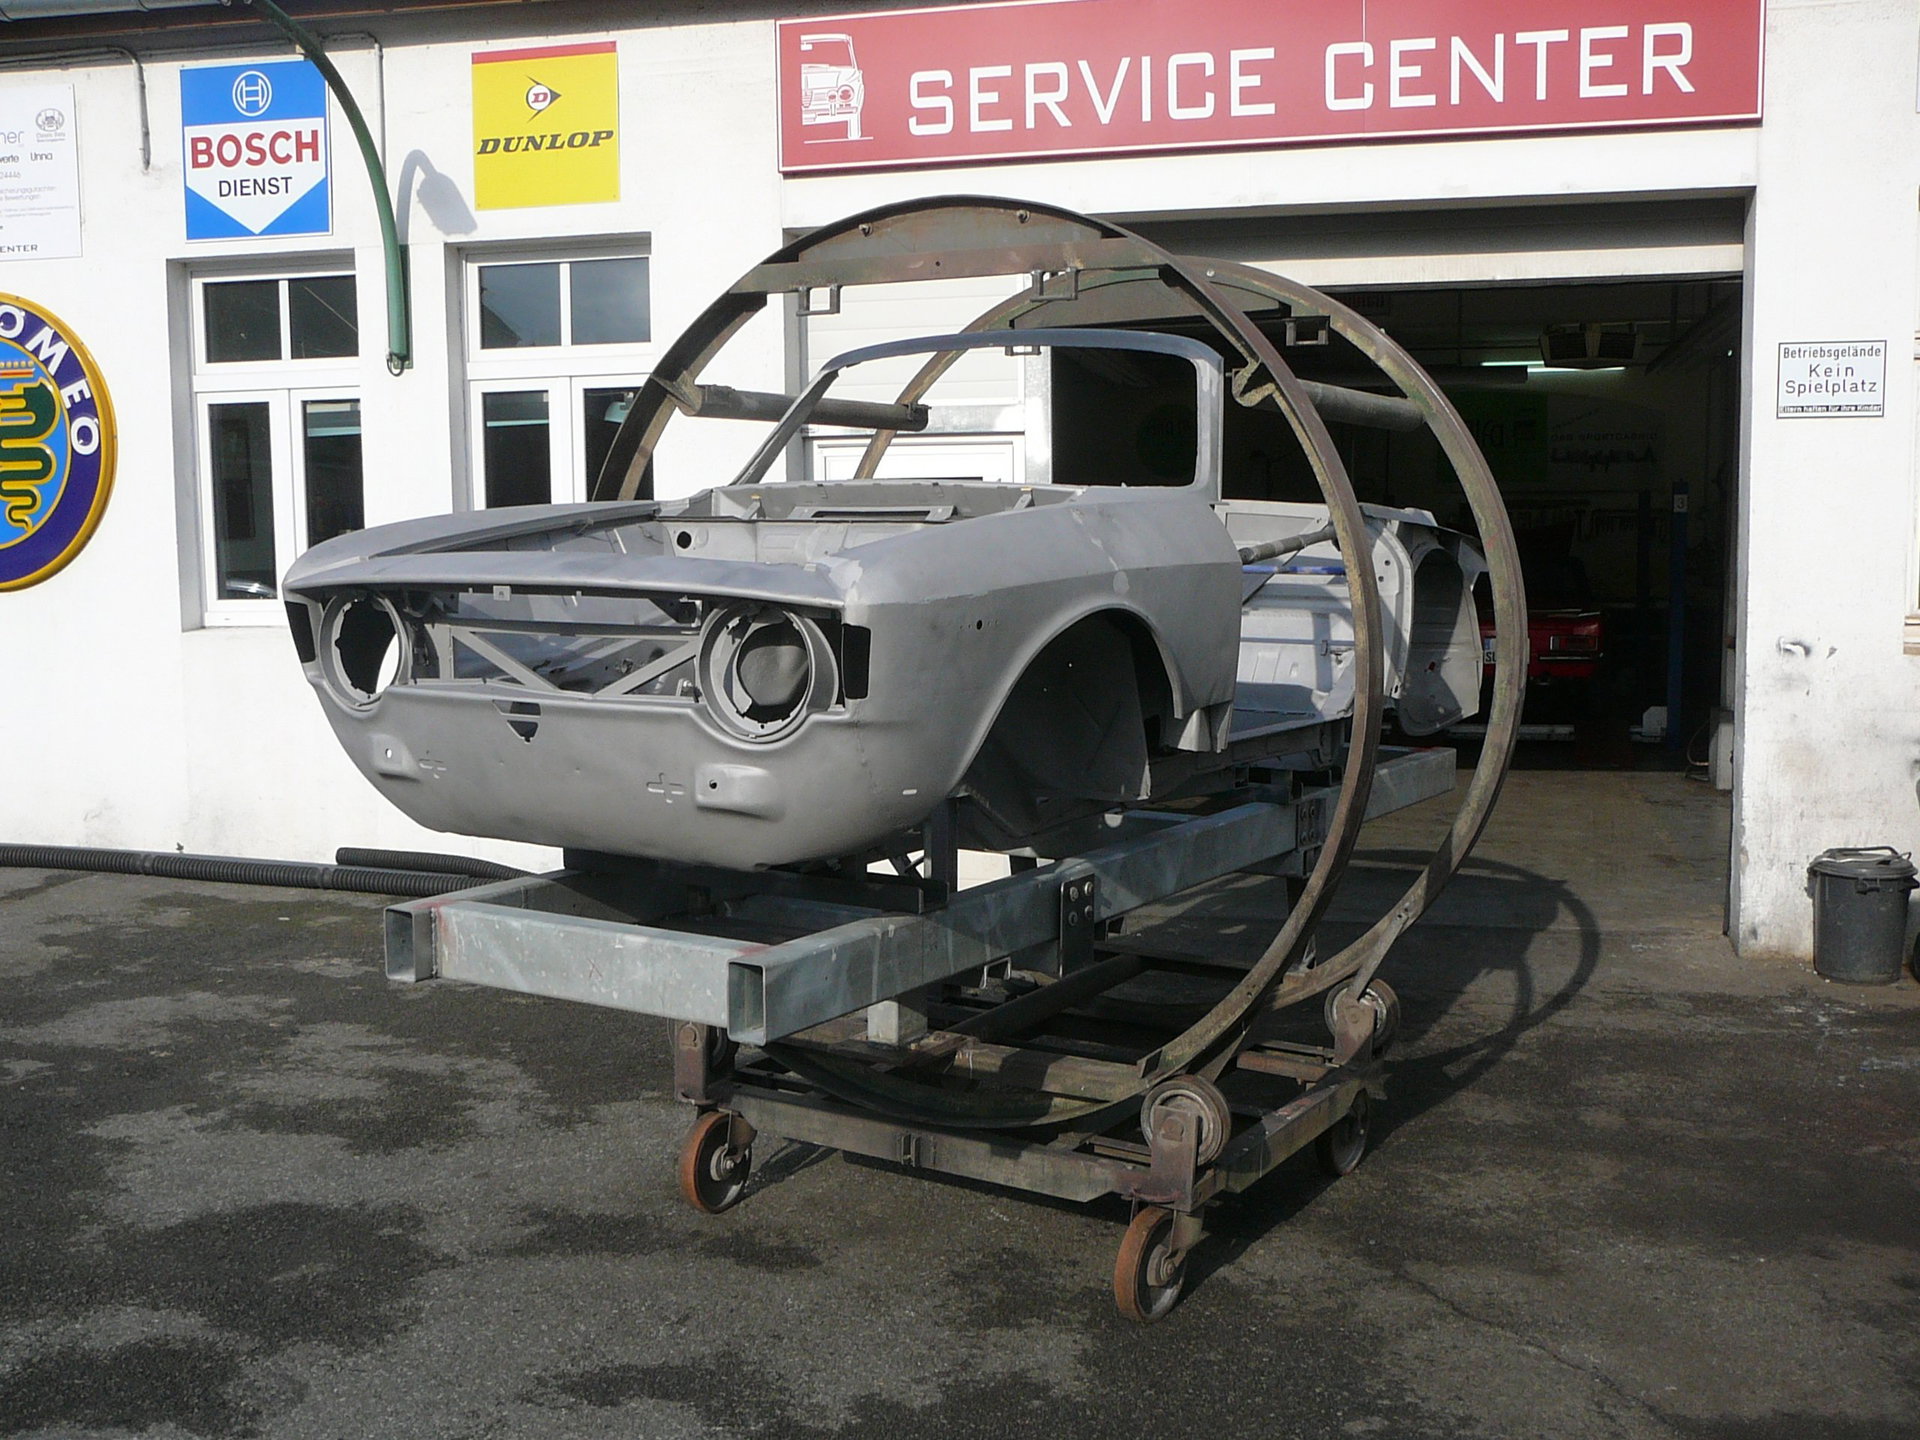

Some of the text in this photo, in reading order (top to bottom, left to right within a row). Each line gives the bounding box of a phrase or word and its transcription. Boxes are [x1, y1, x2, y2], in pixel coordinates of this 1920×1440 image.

[908, 20, 1696, 136] SERVICE CENTER
[531, 92, 549, 103] D
[190, 129, 319, 169] BOSCH
[477, 130, 614, 155] DUNLOP
[30, 152, 53, 161] Unna
[218, 176, 293, 197] DIENST
[1783, 345, 1881, 360] Betriebsgelände
[1808, 363, 1855, 378] Kein
[1785, 378, 1877, 397] Spielplatz
[1677, 496, 1685, 509] 3
